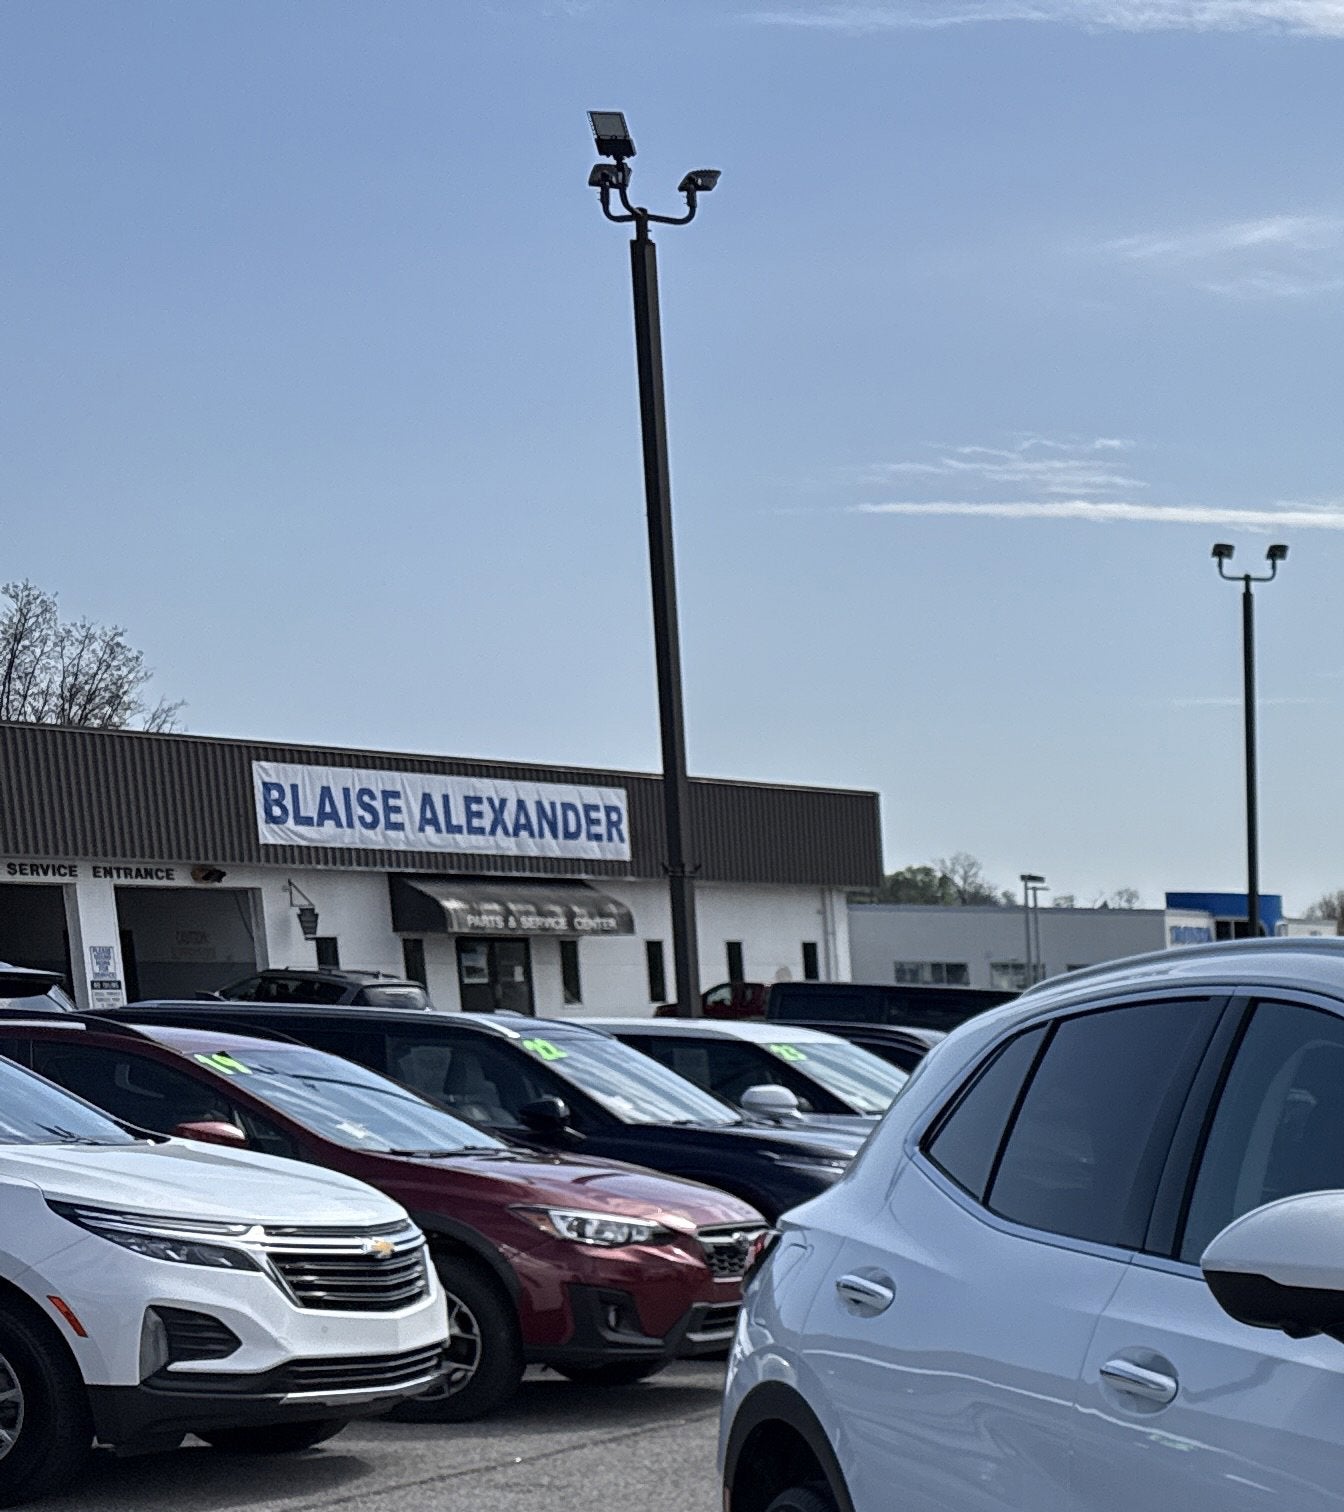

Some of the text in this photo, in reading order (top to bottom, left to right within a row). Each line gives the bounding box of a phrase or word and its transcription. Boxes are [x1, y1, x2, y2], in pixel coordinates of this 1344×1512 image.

[262, 781, 625, 843] BLAISE ALEXANDER
[7, 862, 175, 881] SERVICE ENTRANCE
[467, 914, 617, 931] PARTS & SERVICE CENTER
